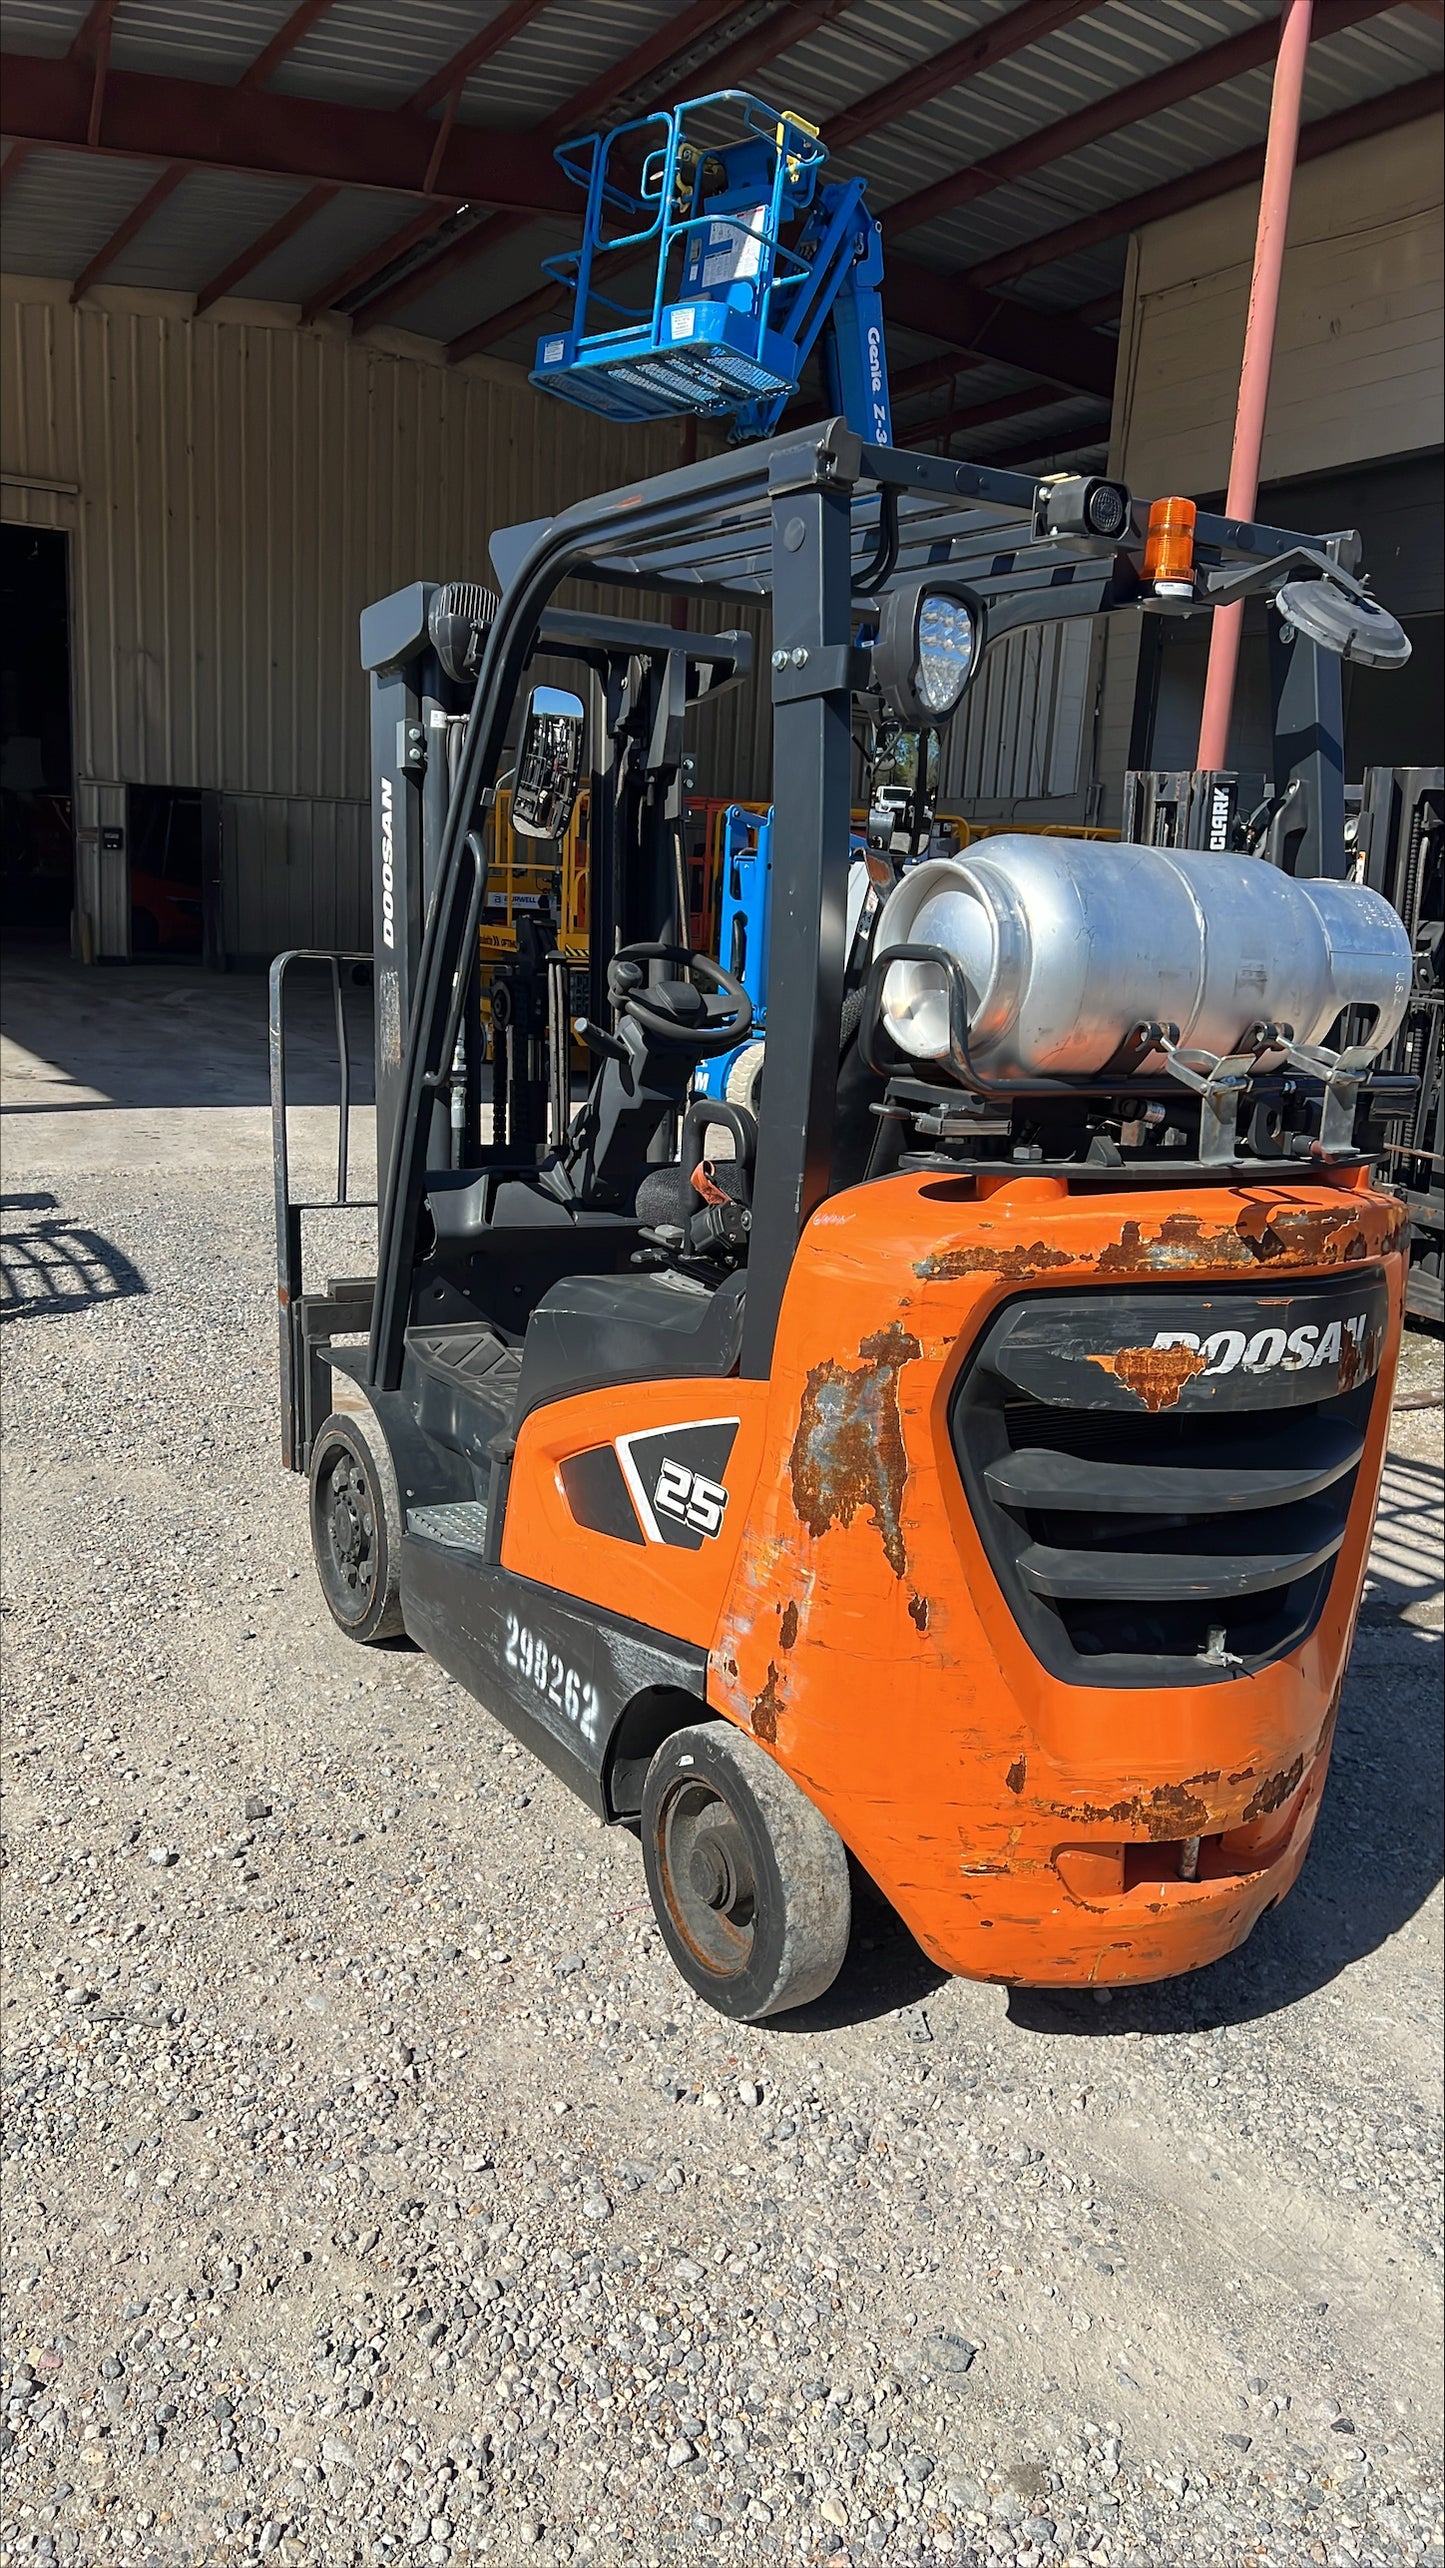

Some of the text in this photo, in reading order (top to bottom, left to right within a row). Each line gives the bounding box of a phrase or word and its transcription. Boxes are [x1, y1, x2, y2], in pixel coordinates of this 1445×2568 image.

[867, 326, 888, 447] Genie Z-3
[381, 776, 394, 950] DOOSAN
[1209, 787, 1230, 850] CLARK
[654, 1456, 730, 1540] 25
[504, 1609, 600, 1747] 298262
